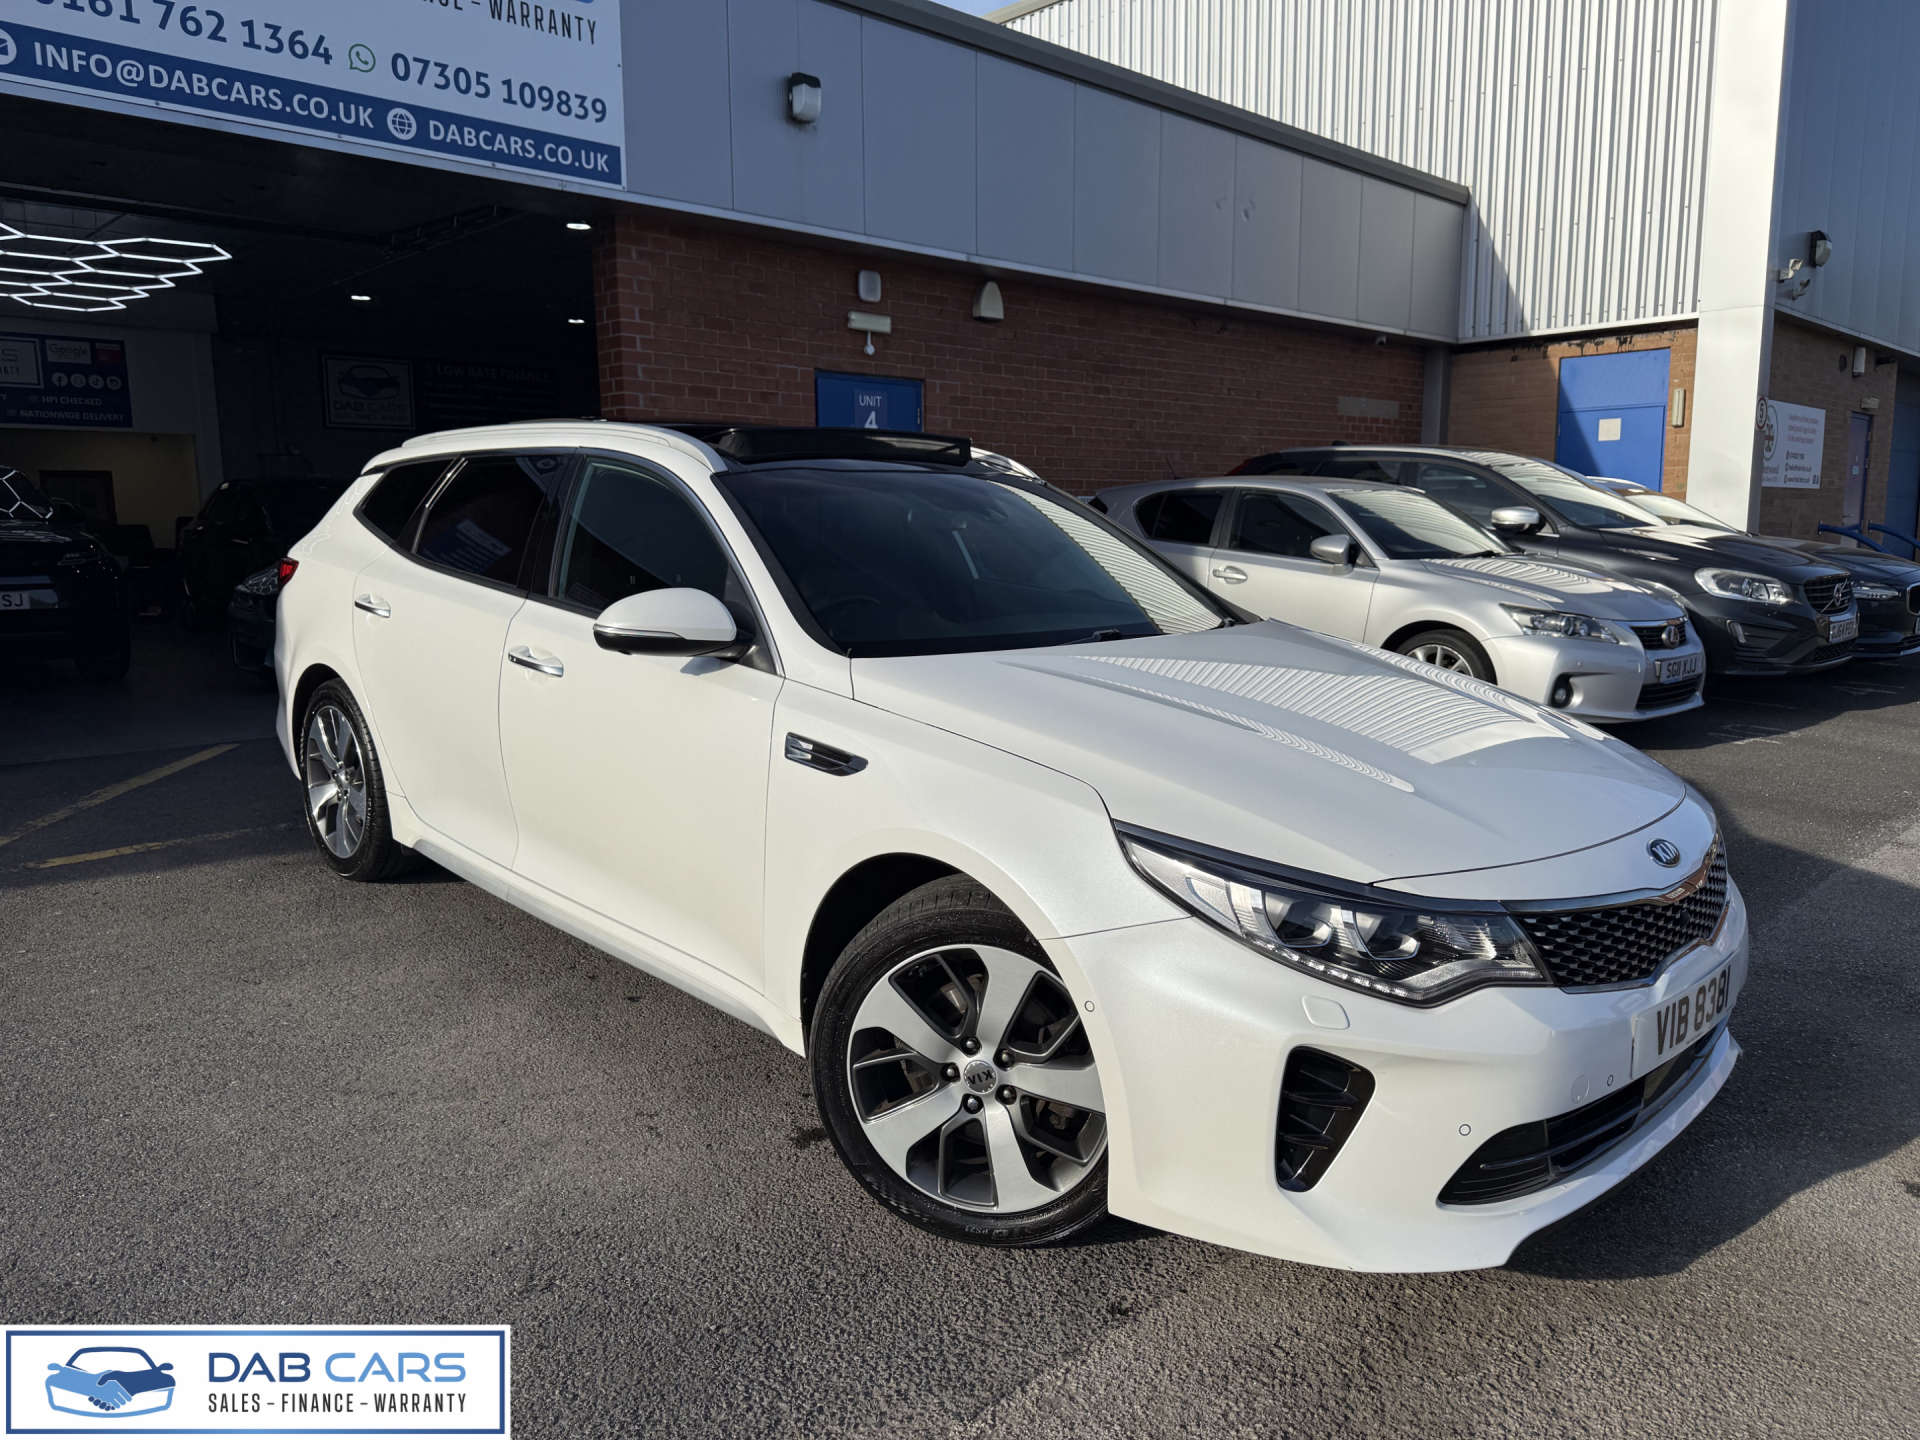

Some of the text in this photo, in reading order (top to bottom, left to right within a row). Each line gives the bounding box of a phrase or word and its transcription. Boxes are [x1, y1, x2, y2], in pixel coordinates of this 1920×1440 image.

[489, 0, 597, 45] WARRANTY
[153, 0, 228, 43] 762
[240, 19, 333, 65] 1364
[391, 53, 491, 98] 07305
[501, 79, 608, 123] 109839
[34, 42, 610, 173] INFO@DABCARS.CO.UK DABCARS.CO.UK
[858, 394, 883, 408] UNIT
[863, 410, 879, 429] 4
[1656, 964, 1731, 1056] VIB 8381
